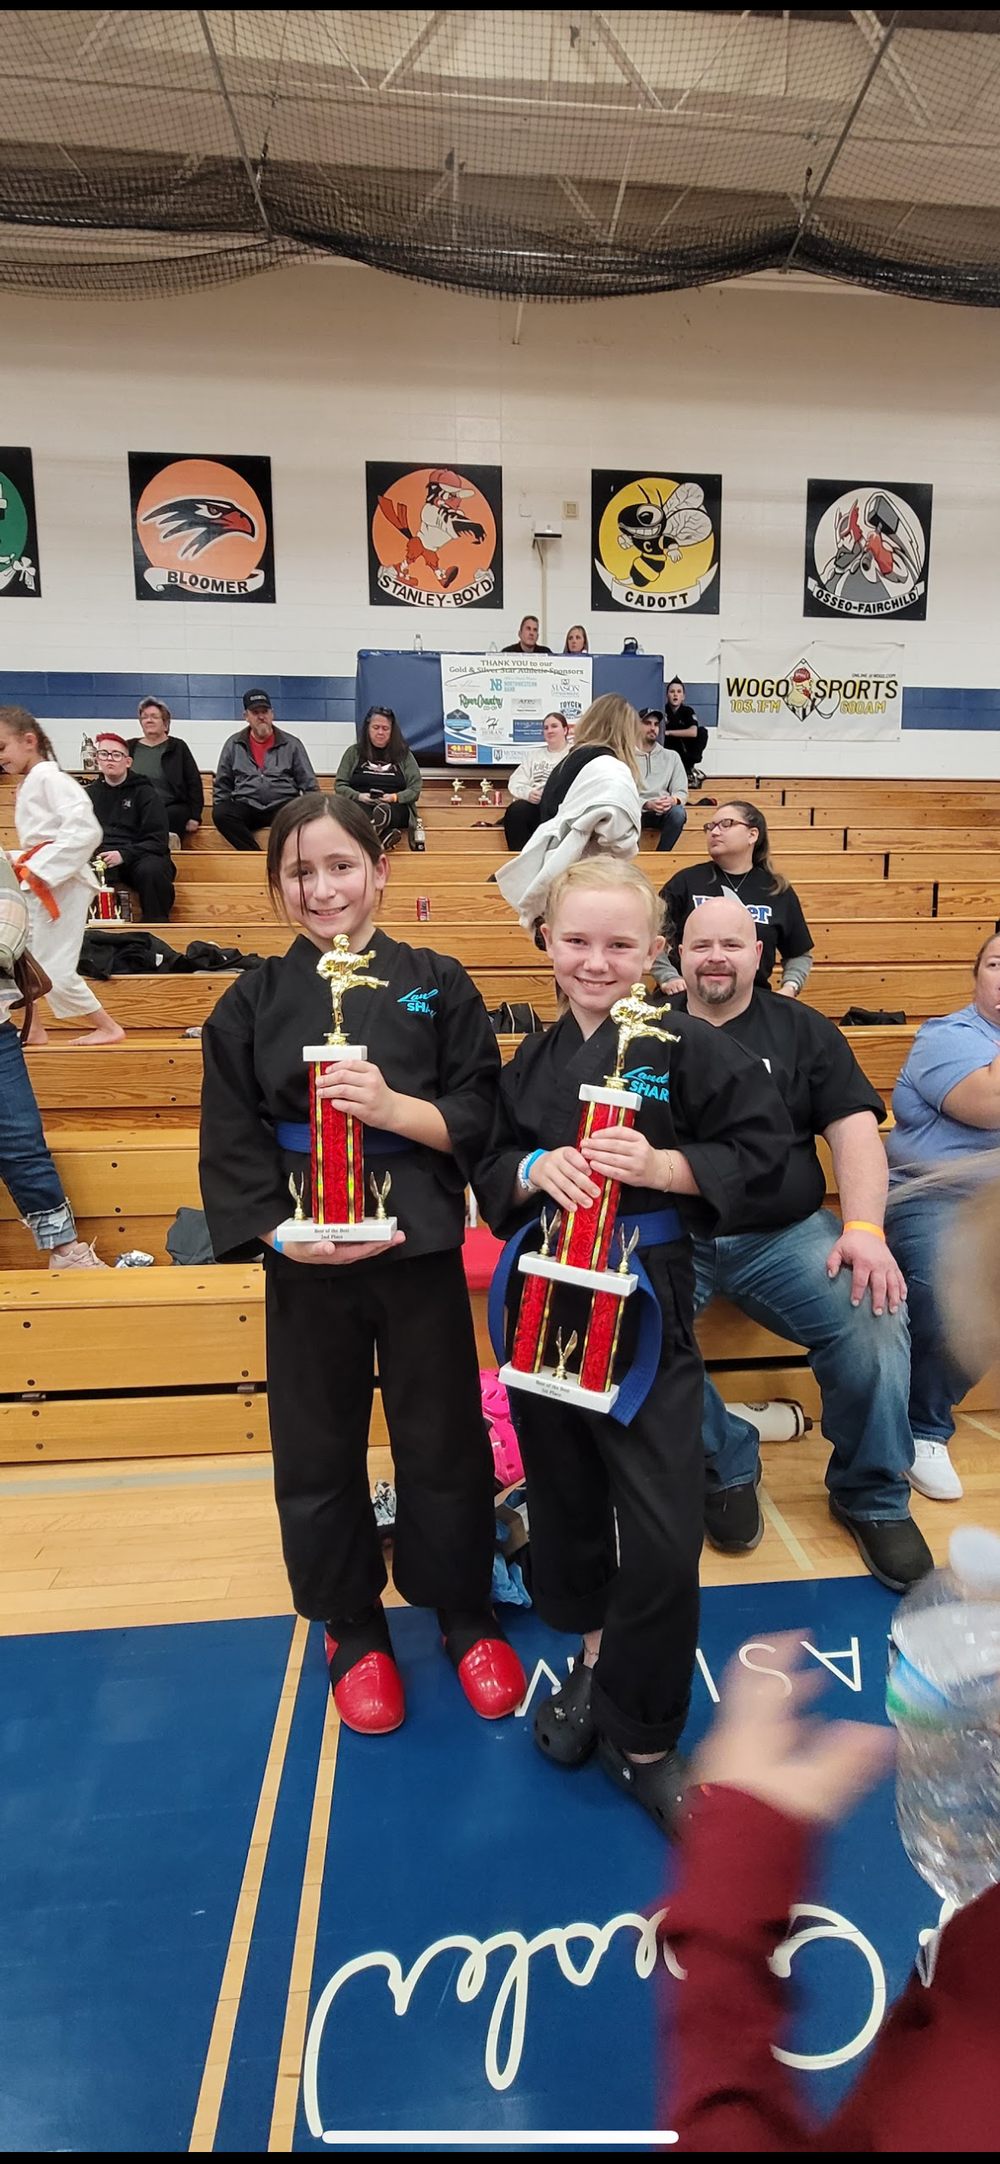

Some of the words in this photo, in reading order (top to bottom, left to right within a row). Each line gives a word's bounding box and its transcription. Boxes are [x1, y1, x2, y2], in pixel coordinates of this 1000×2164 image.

[167, 571, 249, 593] BLOOMER
[380, 575, 492, 606] STANLEY-BOYD
[625, 591, 688, 608] CADOTT
[816, 589, 916, 614] OSSEO-FAIRCHILD
[549, 668, 584, 676] Sponsors
[726, 678, 790, 698] WOGO
[814, 679, 898, 699] SPORTS
